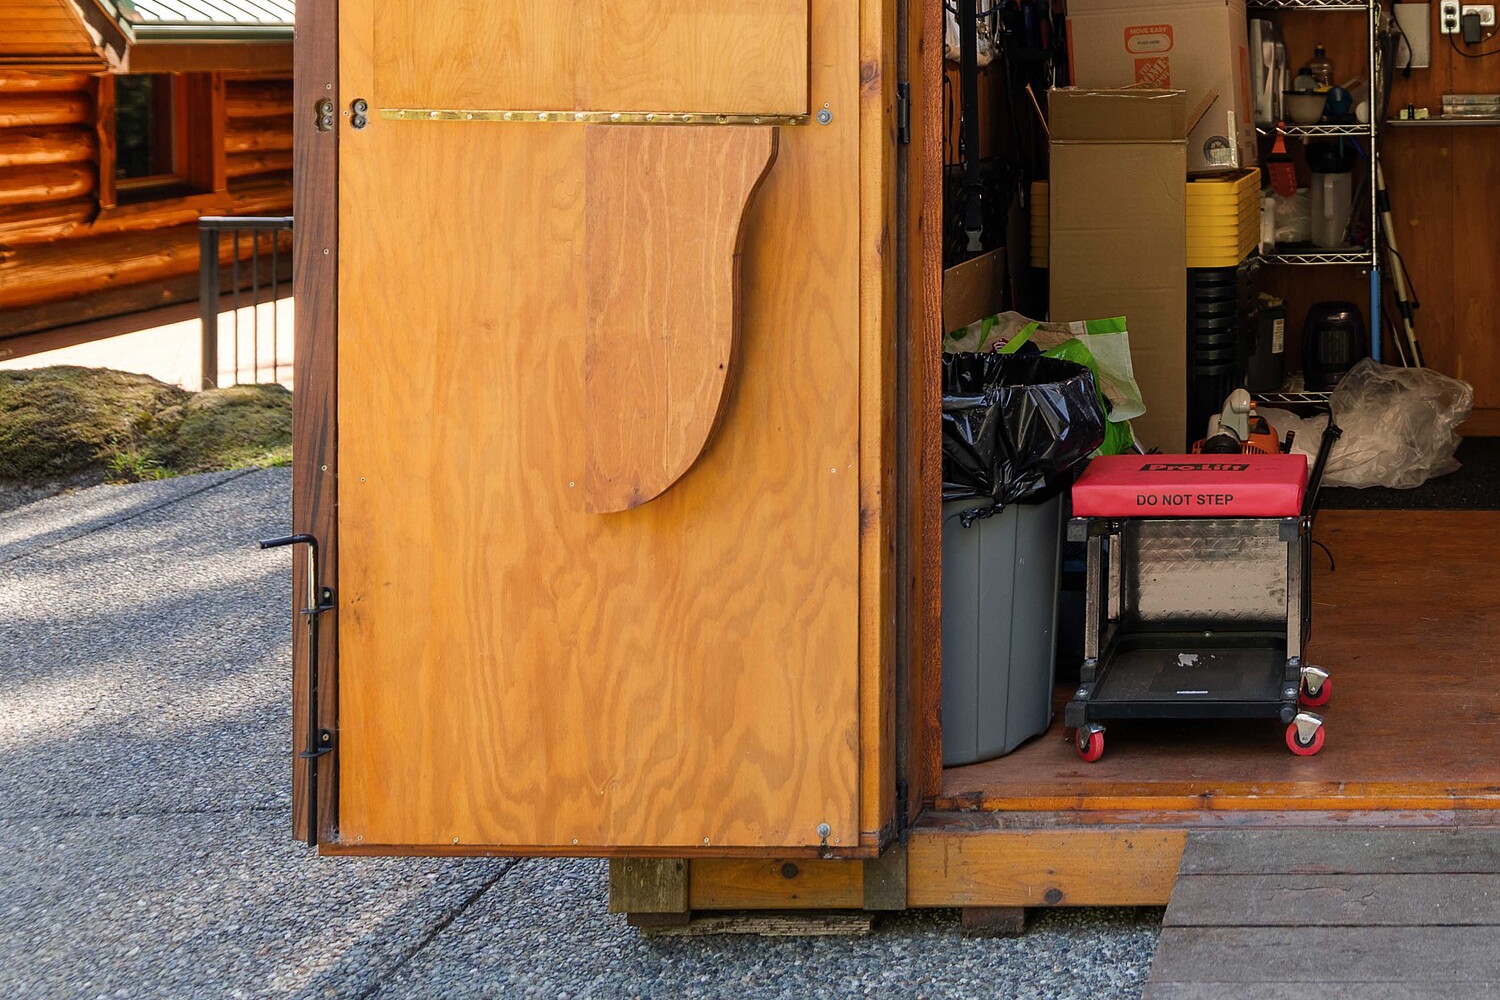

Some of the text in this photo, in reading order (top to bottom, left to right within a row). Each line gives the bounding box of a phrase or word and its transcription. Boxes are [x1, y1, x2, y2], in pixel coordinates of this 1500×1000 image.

[1137, 494, 1234, 506] DO NOT STEP
